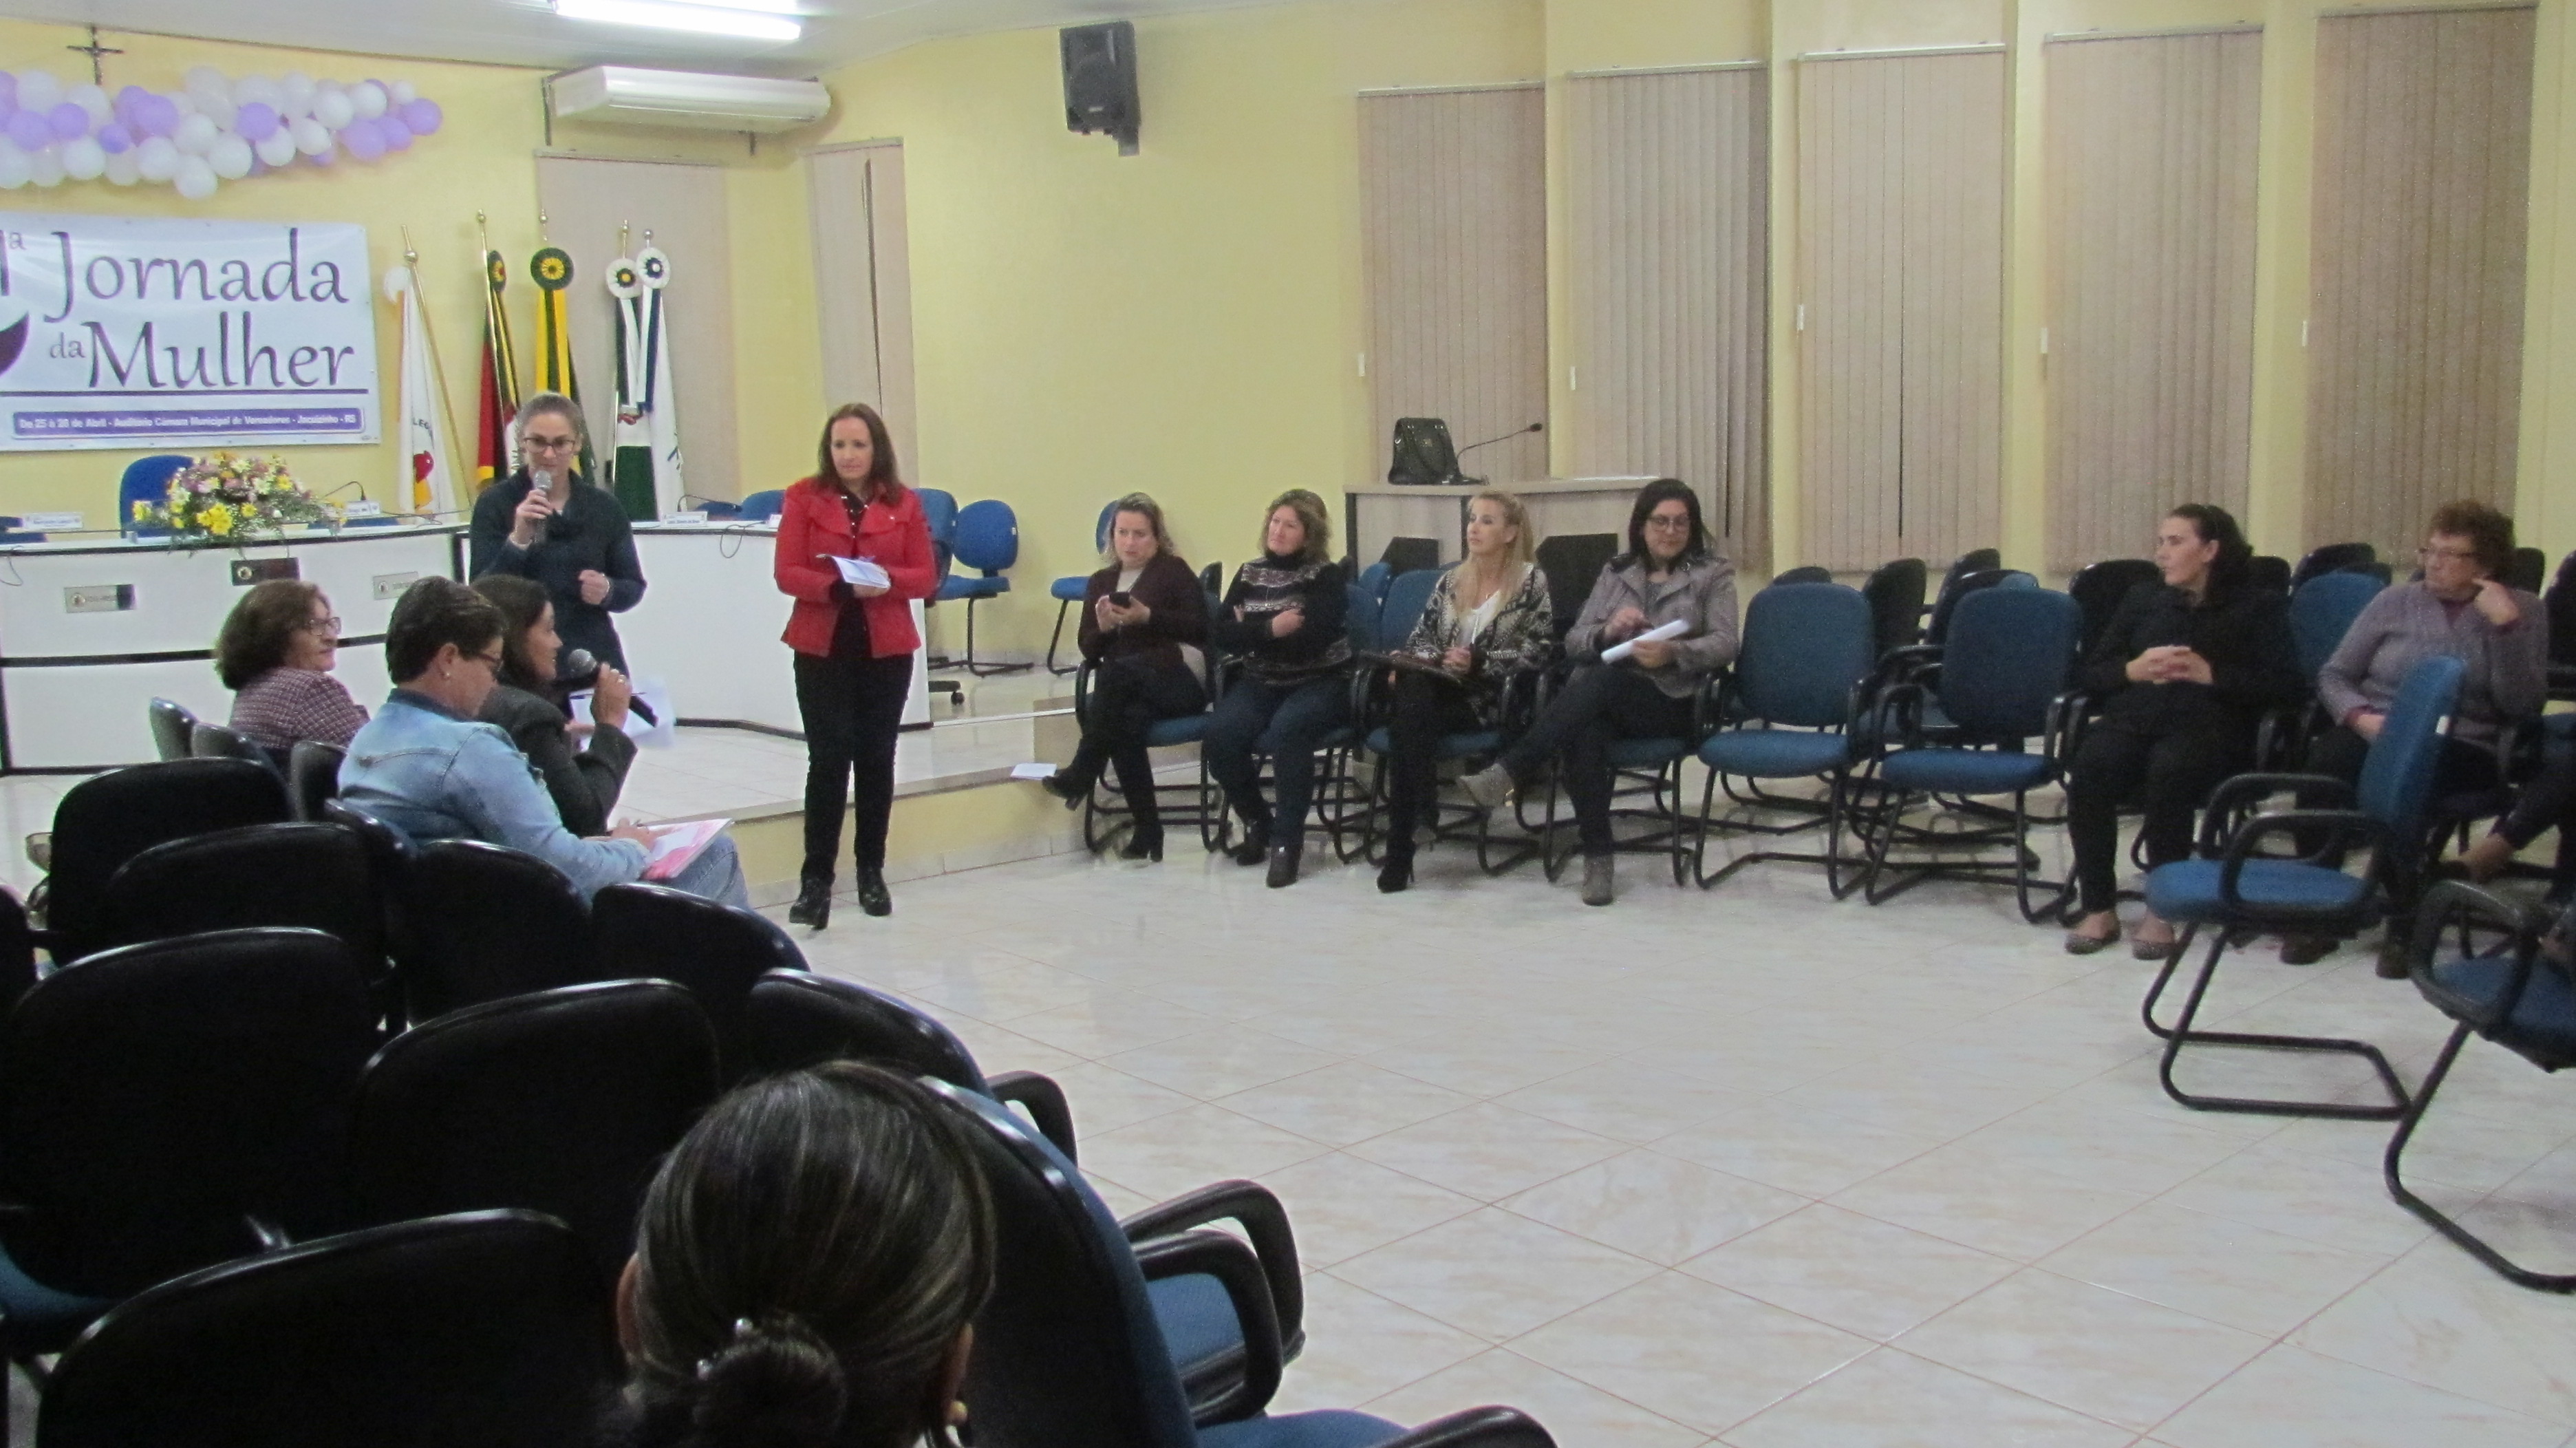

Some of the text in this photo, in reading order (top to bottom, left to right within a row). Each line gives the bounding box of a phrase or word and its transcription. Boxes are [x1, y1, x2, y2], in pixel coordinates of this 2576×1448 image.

[43, 228, 350, 323] Jornada
[50, 311, 355, 388] da Mulher
